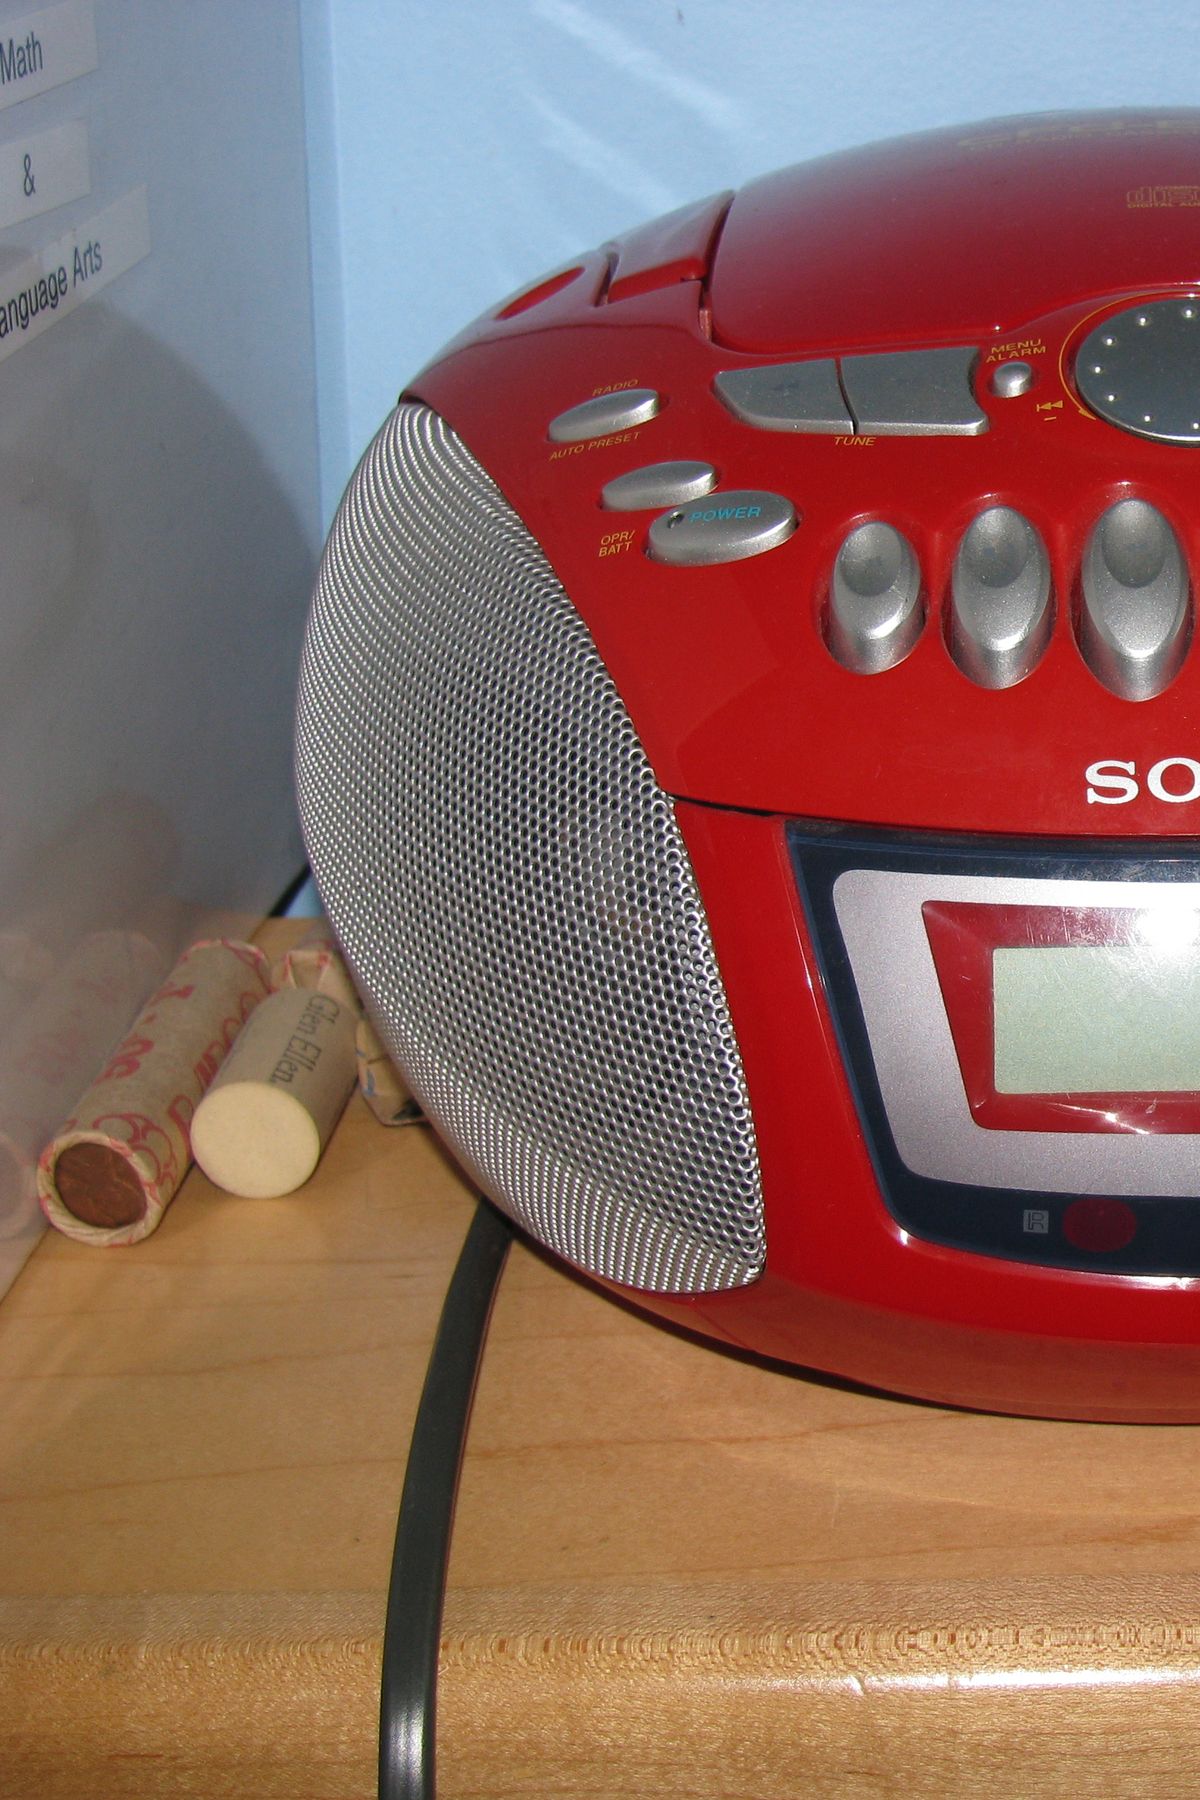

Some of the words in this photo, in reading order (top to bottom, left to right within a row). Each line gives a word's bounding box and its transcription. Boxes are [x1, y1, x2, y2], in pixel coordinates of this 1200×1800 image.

[0, 31, 44, 85] Math
[23, 153, 36, 197] &
[73, 241, 103, 288] Arts
[985, 346, 1046, 363] ALARM
[991, 338, 1041, 354] MENU
[592, 379, 639, 397] RADIO
[549, 444, 585, 462] AUTO
[588, 431, 641, 451] PRESET
[833, 436, 876, 446] TUNE
[688, 506, 762, 523] POWER
[600, 530, 636, 547] OPR/
[598, 541, 633, 558] BATT
